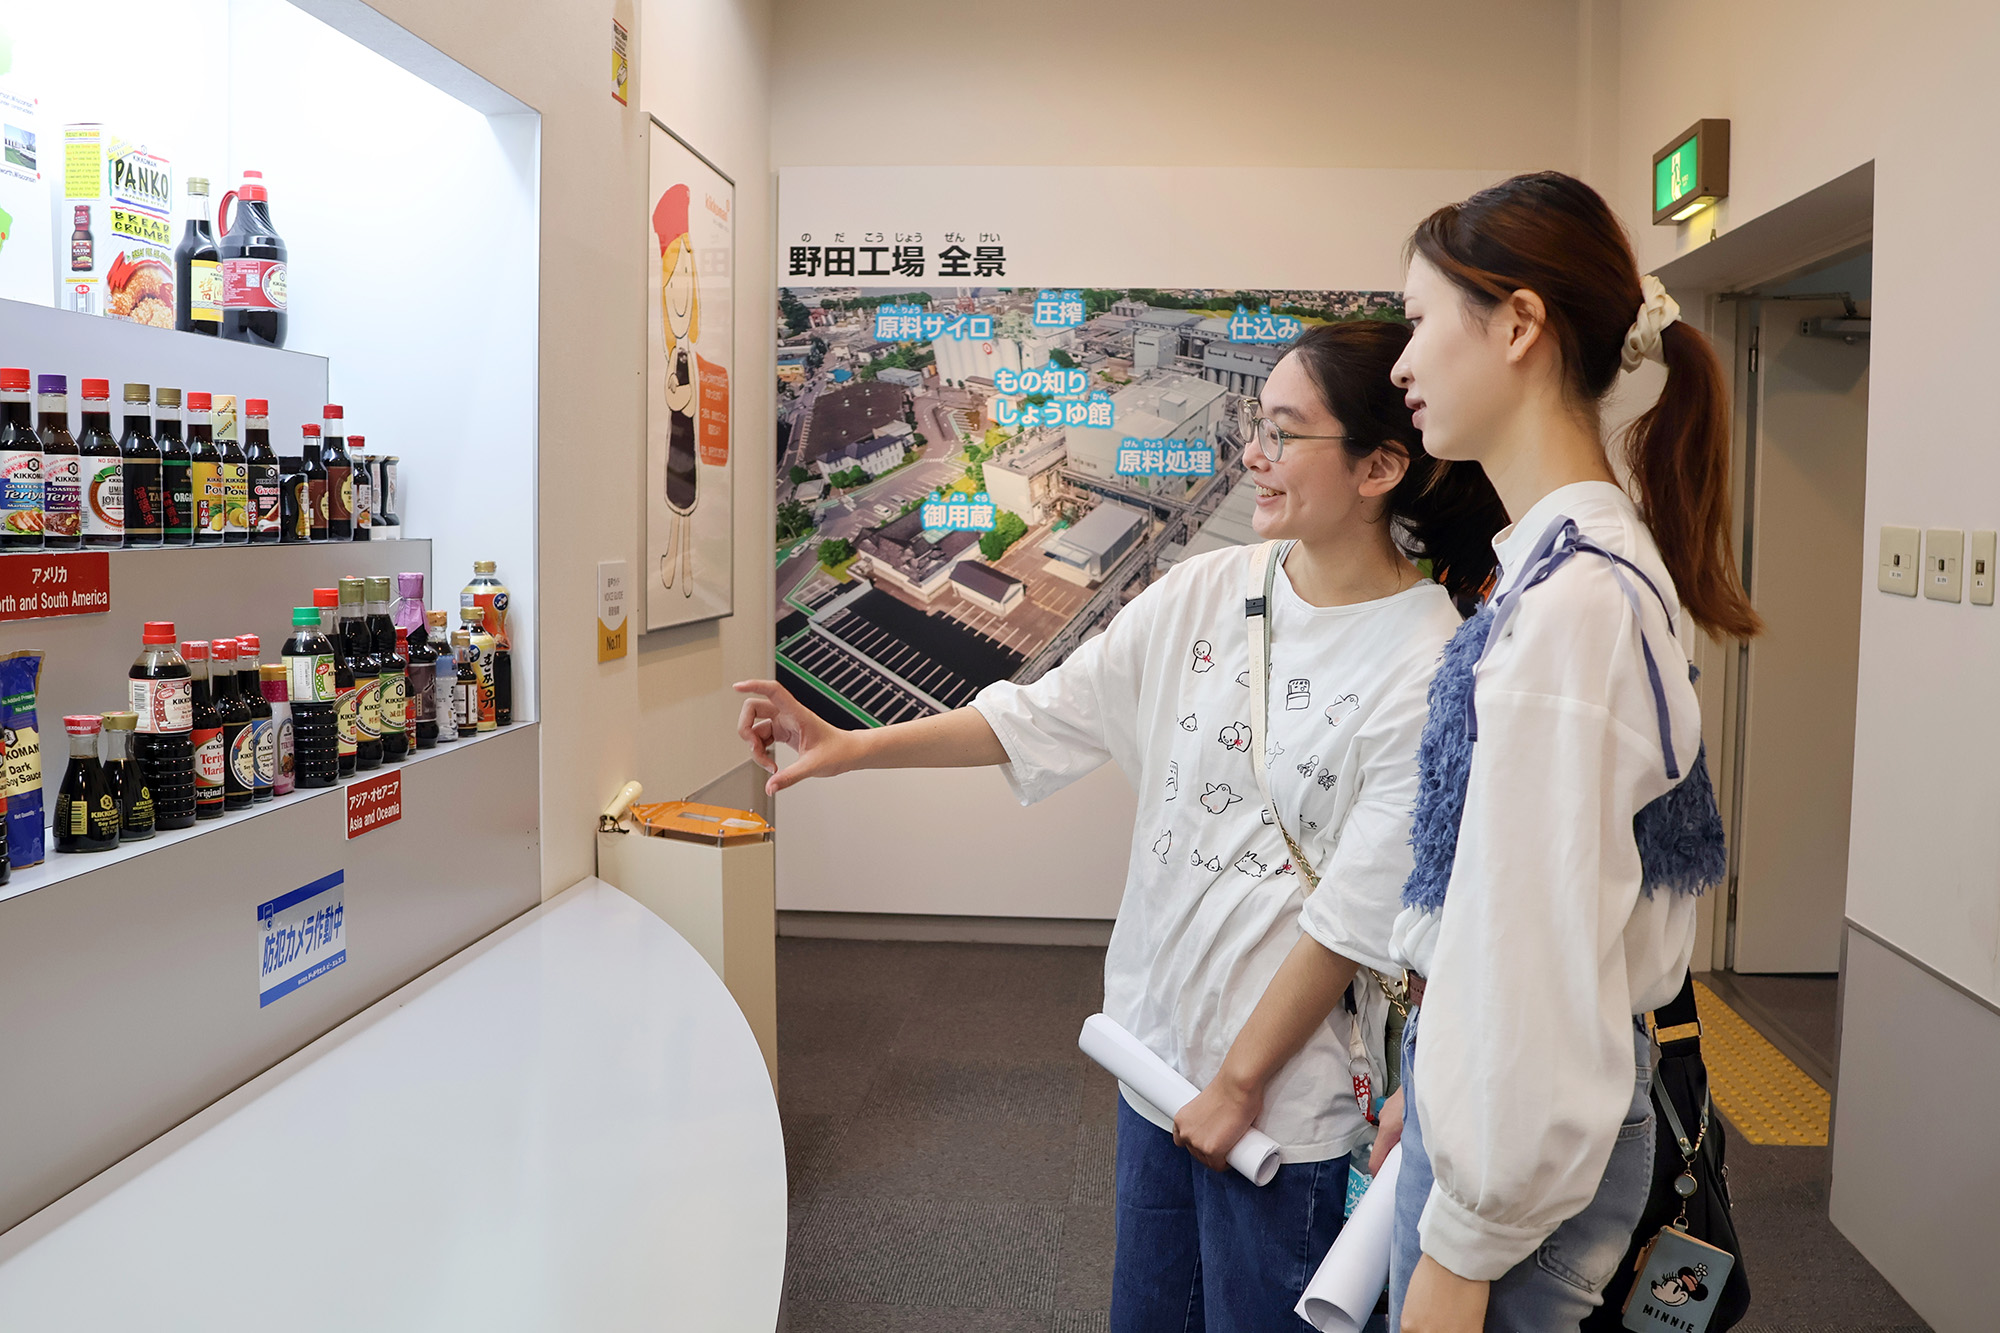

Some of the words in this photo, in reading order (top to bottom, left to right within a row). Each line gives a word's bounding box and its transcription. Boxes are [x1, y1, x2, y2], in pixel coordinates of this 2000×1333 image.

[115, 158, 169, 202] PANKO
[115, 211, 170, 232] BREAD
[115, 222, 170, 244] CRUMBS
[801, 233, 812, 243] の
[835, 232, 846, 243] だ
[864, 233, 885, 243] こう
[894, 232, 923, 243] じょう
[944, 232, 965, 243] ぜん
[979, 232, 1001, 243] けい
[788, 245, 926, 277] 野田工場
[938, 245, 1007, 277] 全景
[881, 306, 896, 315] げん
[901, 306, 921, 315] りょう
[1035, 301, 1083, 325] 圧搾
[876, 315, 991, 339] 原料サイロ
[1230, 316, 1300, 340] 仕込み
[996, 370, 1087, 394] もの知り
[998, 401, 1112, 426] しょうゆ館
[1123, 440, 1139, 449] げん
[1144, 440, 1163, 449] りょう
[1169, 441, 1183, 449] しょ
[1118, 449, 1212, 474] 原料処理
[923, 503, 994, 529] 御用蔵
[31, 565, 68, 585] アメリカ
[19, 592, 38, 611] and
[41, 590, 69, 609] South
[71, 588, 108, 607] America
[606, 633, 621, 651] No.11
[8, 762, 32, 775] Dark
[18, 771, 42, 784] Sauce
[350, 780, 399, 810] アジア・オセアニア
[350, 815, 363, 832] Asia
[364, 808, 375, 826] and
[376, 801, 400, 821] Oceania
[262, 901, 344, 978] 防犯カメラ作動中
[1642, 1304, 1695, 1333] MINNIE
